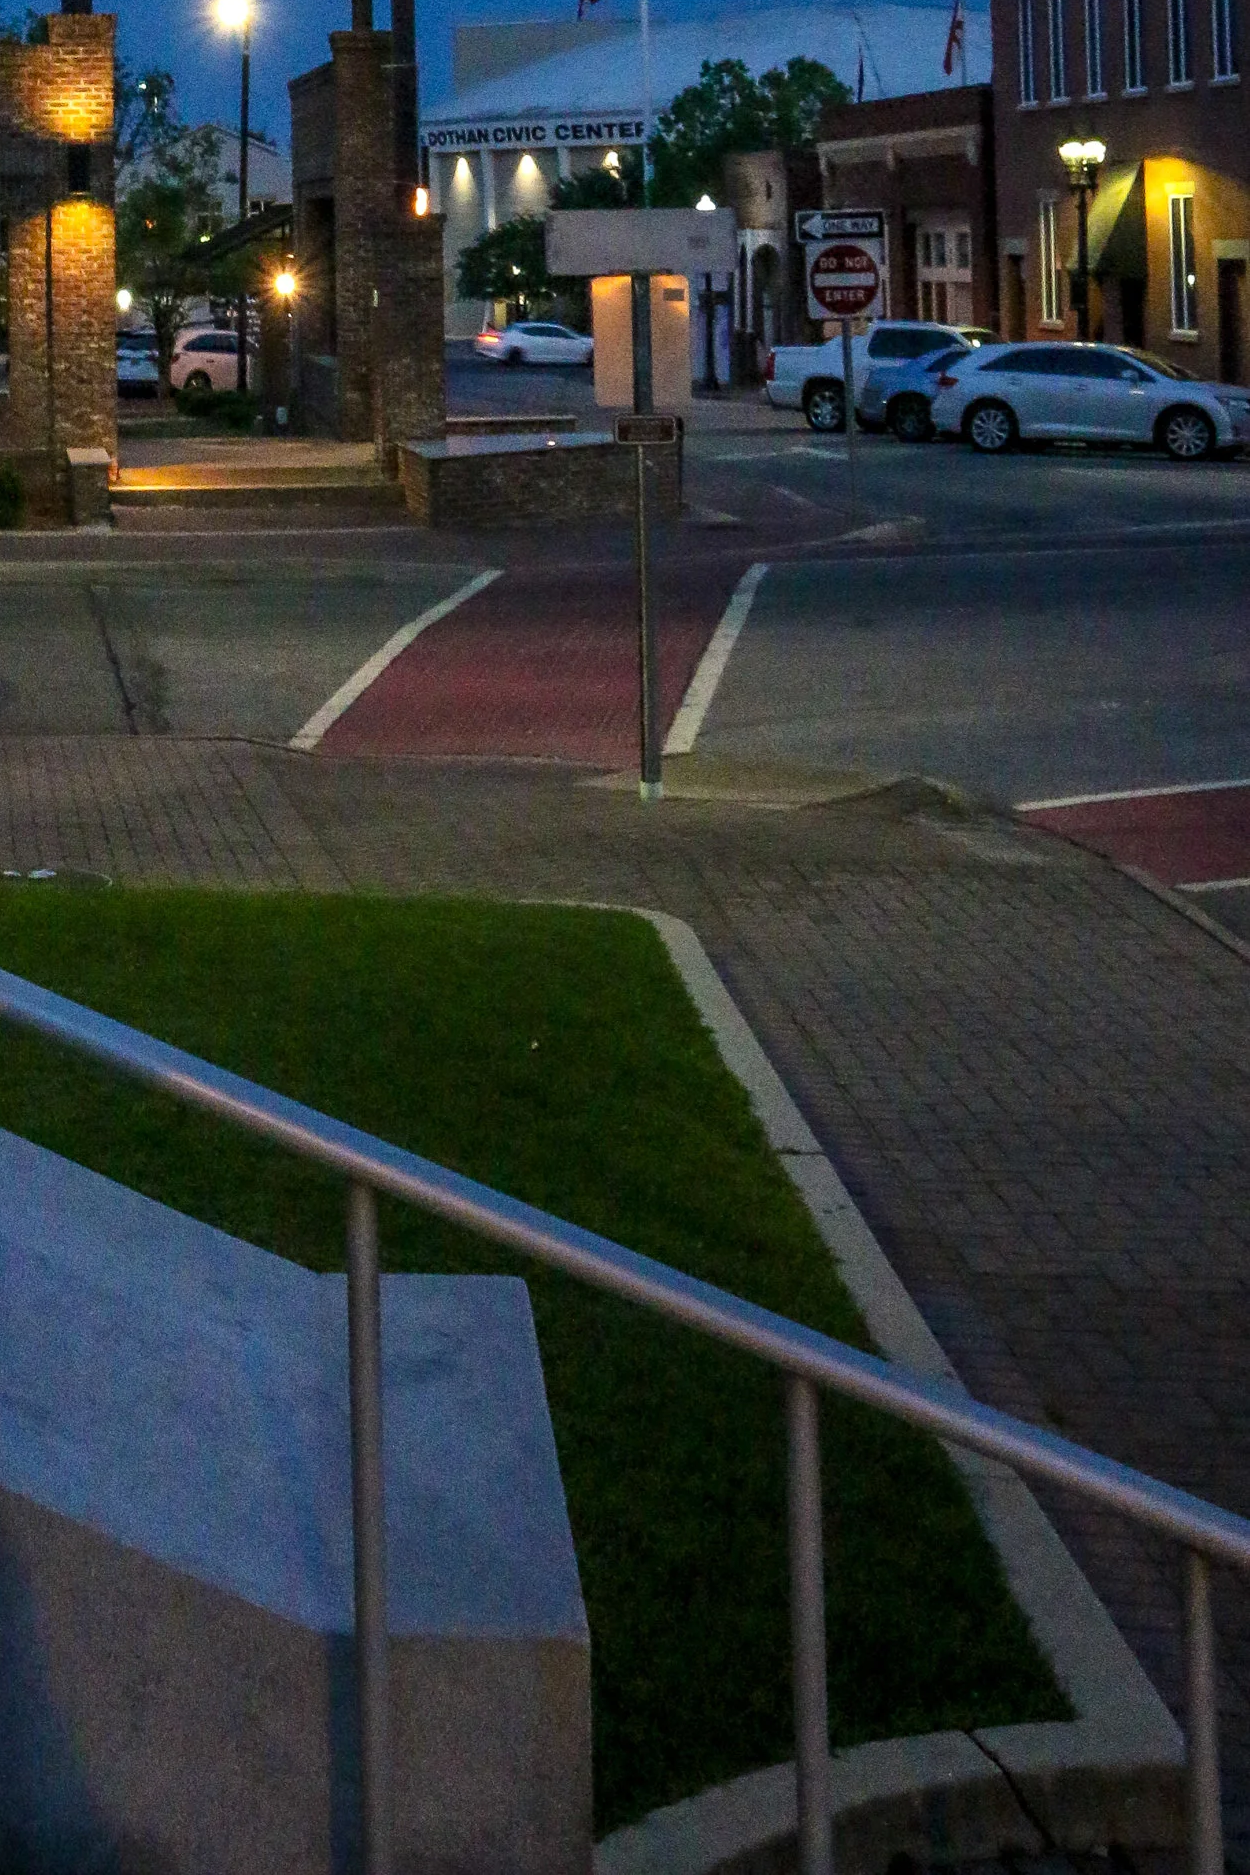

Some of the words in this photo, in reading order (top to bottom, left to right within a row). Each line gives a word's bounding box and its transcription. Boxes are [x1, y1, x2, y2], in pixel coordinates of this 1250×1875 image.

[428, 129, 488, 146] DOTHAN
[493, 125, 546, 142] CIVIC
[820, 257, 838, 269] DO
[845, 257, 869, 269] NOT
[825, 289, 865, 302] ENTER
